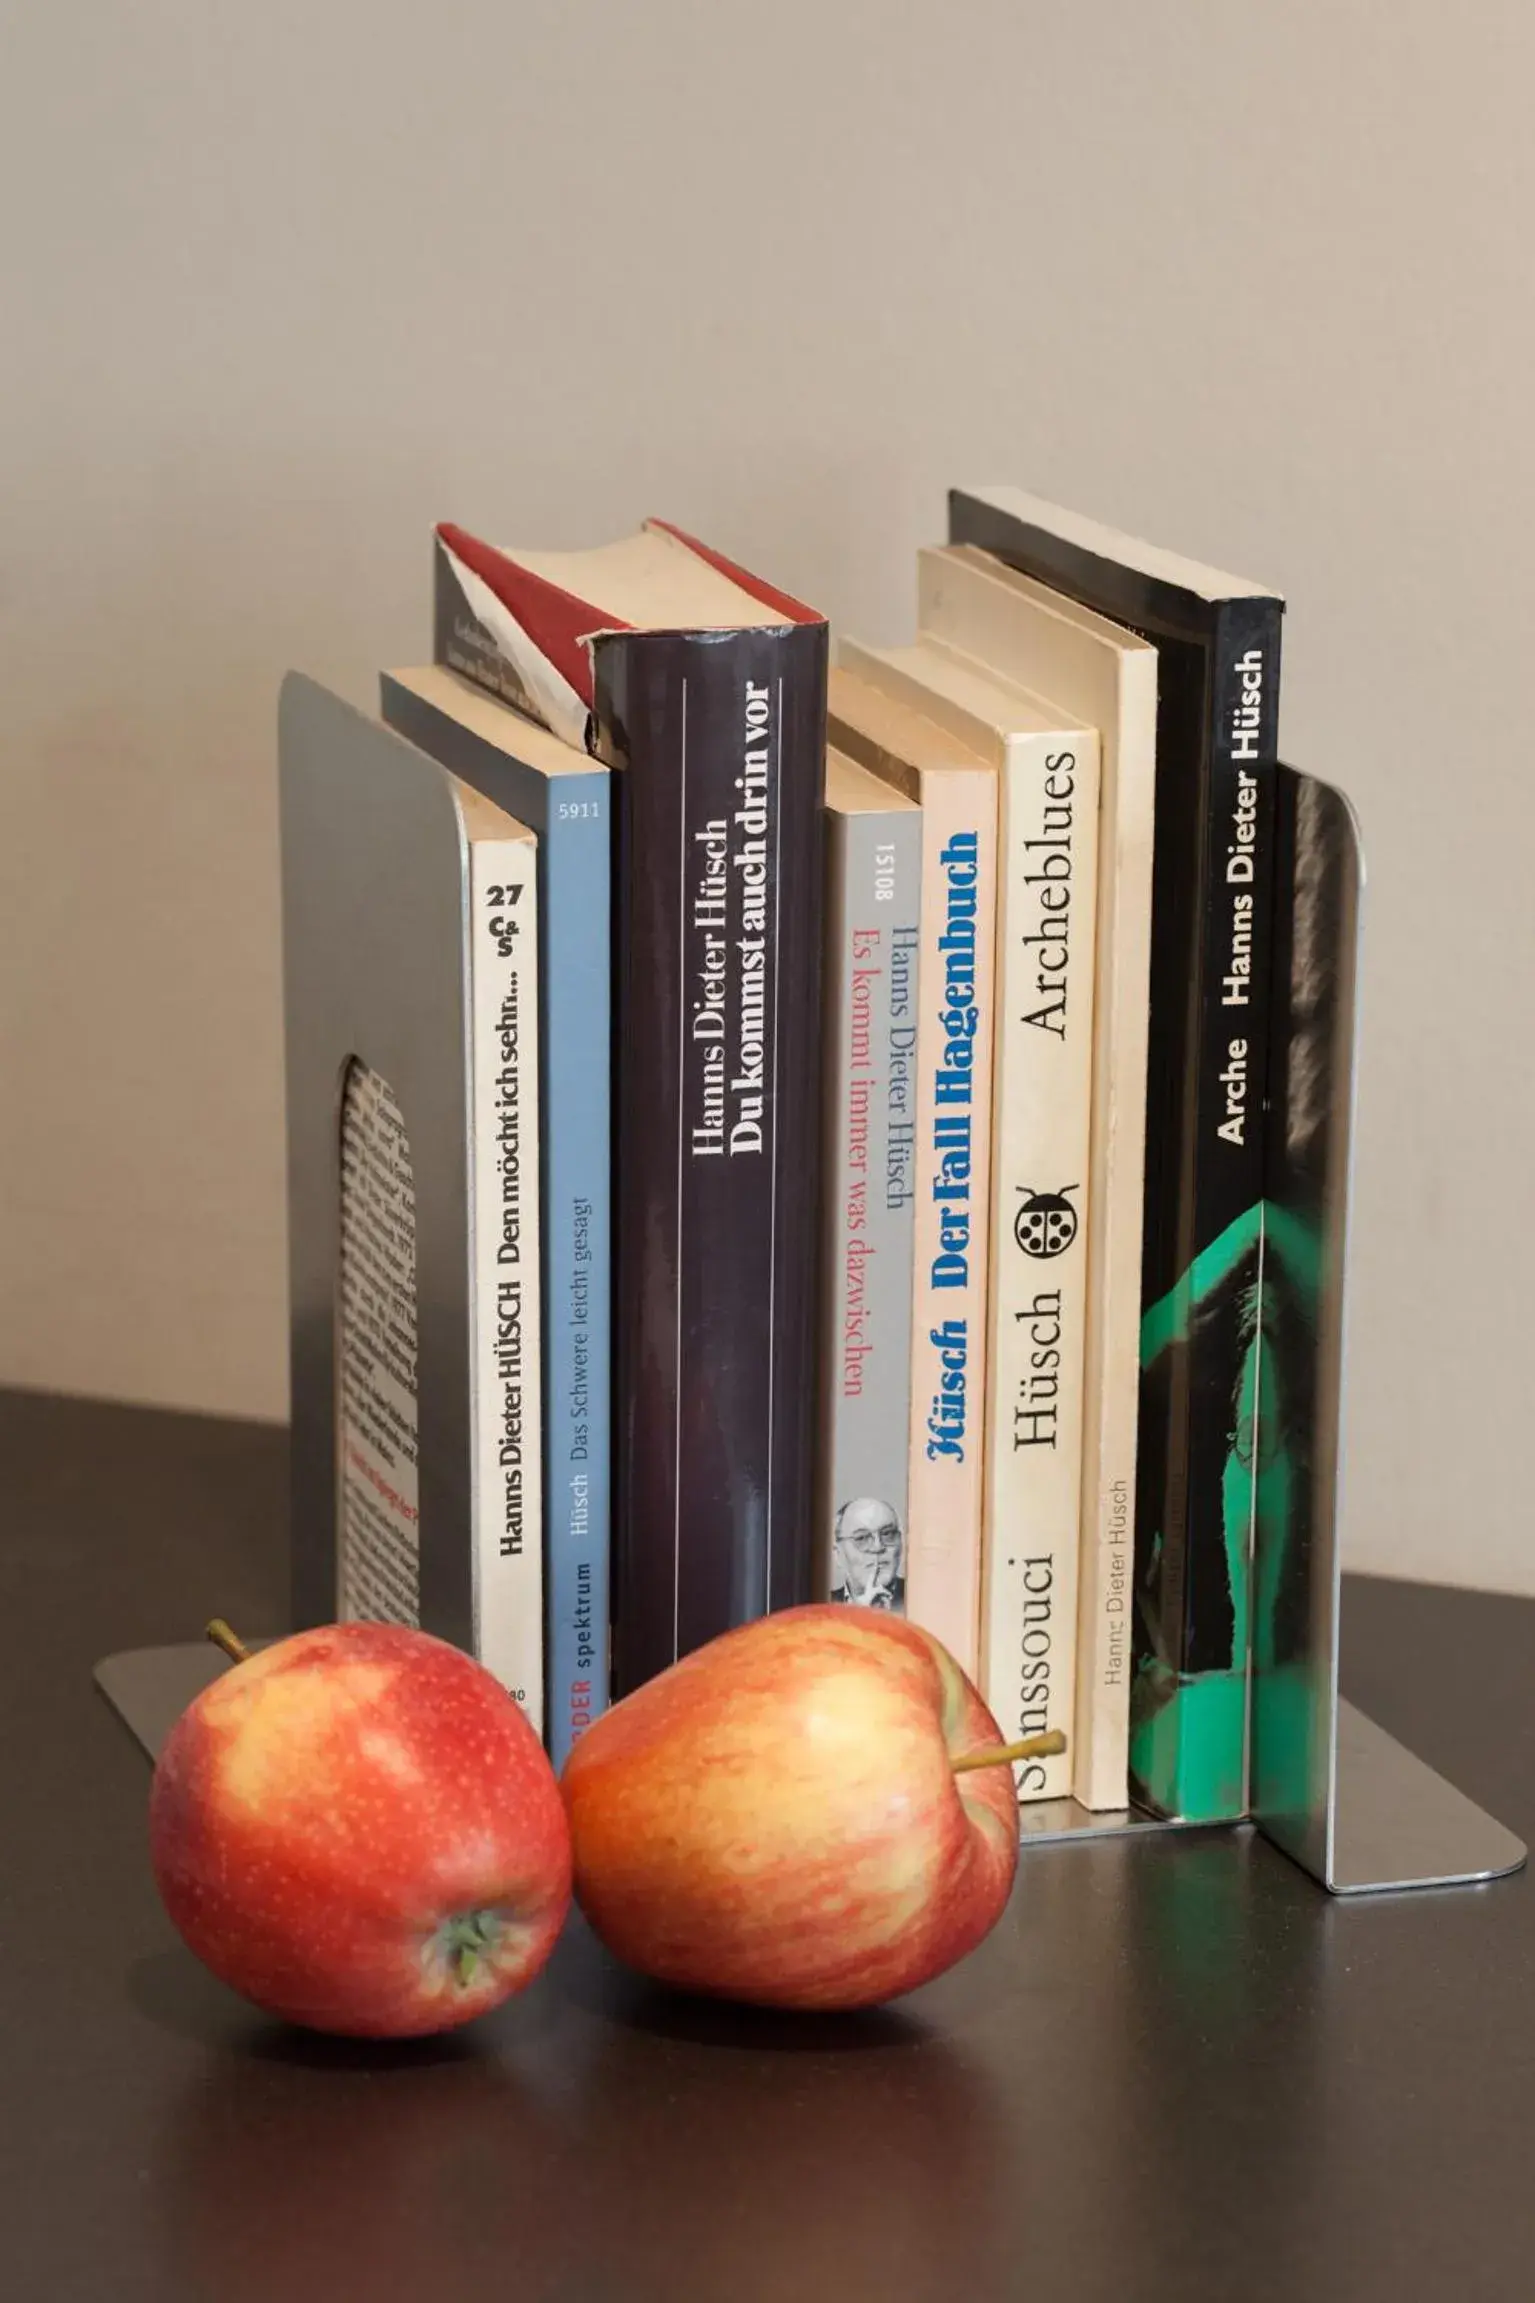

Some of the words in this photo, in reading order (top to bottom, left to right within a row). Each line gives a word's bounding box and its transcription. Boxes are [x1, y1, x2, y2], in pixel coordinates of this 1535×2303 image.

[746, 681, 769, 744] vor
[1231, 649, 1264, 761] Hüsch
[559, 801, 599, 819] 5911
[735, 749, 768, 838] drin
[1226, 770, 1259, 884] Dieter
[486, 884, 524, 906] 27
[695, 820, 727, 930] Hüsch
[734, 849, 767, 933] auch
[875, 844, 895, 902] 15108
[1020, 751, 1075, 1041] Archeblues
[694, 933, 725, 1041] Dieter
[853, 926, 881, 960] Es
[890, 926, 918, 1018] Hanns
[935, 830, 978, 1106] Hagenbuch
[1222, 894, 1254, 1006] Hanns
[495, 971, 518, 1063] sehn...
[731, 936, 766, 1091] kommst
[850, 969, 881, 1070] kommt
[495, 1066, 518, 1109] ich
[693, 1046, 724, 1157] Hanns
[888, 1026, 916, 1115] Dieter
[1217, 1037, 1247, 1147] Arche
[496, 1111, 519, 1202] möcht
[731, 1095, 763, 1157] Du
[848, 1080, 876, 1174] immer
[886, 1122, 914, 1210] Hüsch
[933, 1114, 972, 1202] Fall
[497, 1206, 520, 1264] Den
[573, 1197, 591, 1263] gesagt
[846, 1180, 867, 1231] was
[931, 1206, 970, 1290] Der
[493, 1281, 521, 1378] HÜSCH
[568, 1267, 588, 1326] leicht
[844, 1238, 875, 1398] dazwischen
[569, 1332, 588, 1418] Schwere
[927, 1319, 968, 1464] Hüsch
[1014, 1288, 1062, 1452] Hüsch
[498, 1382, 521, 1466] Dieter
[569, 1424, 588, 1462] Das
[500, 1469, 522, 1557] Hanns
[569, 1474, 588, 1536] Hüsch
[1107, 1479, 1128, 1545] Hüsch
[573, 1562, 595, 1669] spektrum
[1106, 1553, 1126, 1614] Dieter
[571, 1680, 592, 1744] DER
[1008, 1553, 1055, 1792] Snssouci
